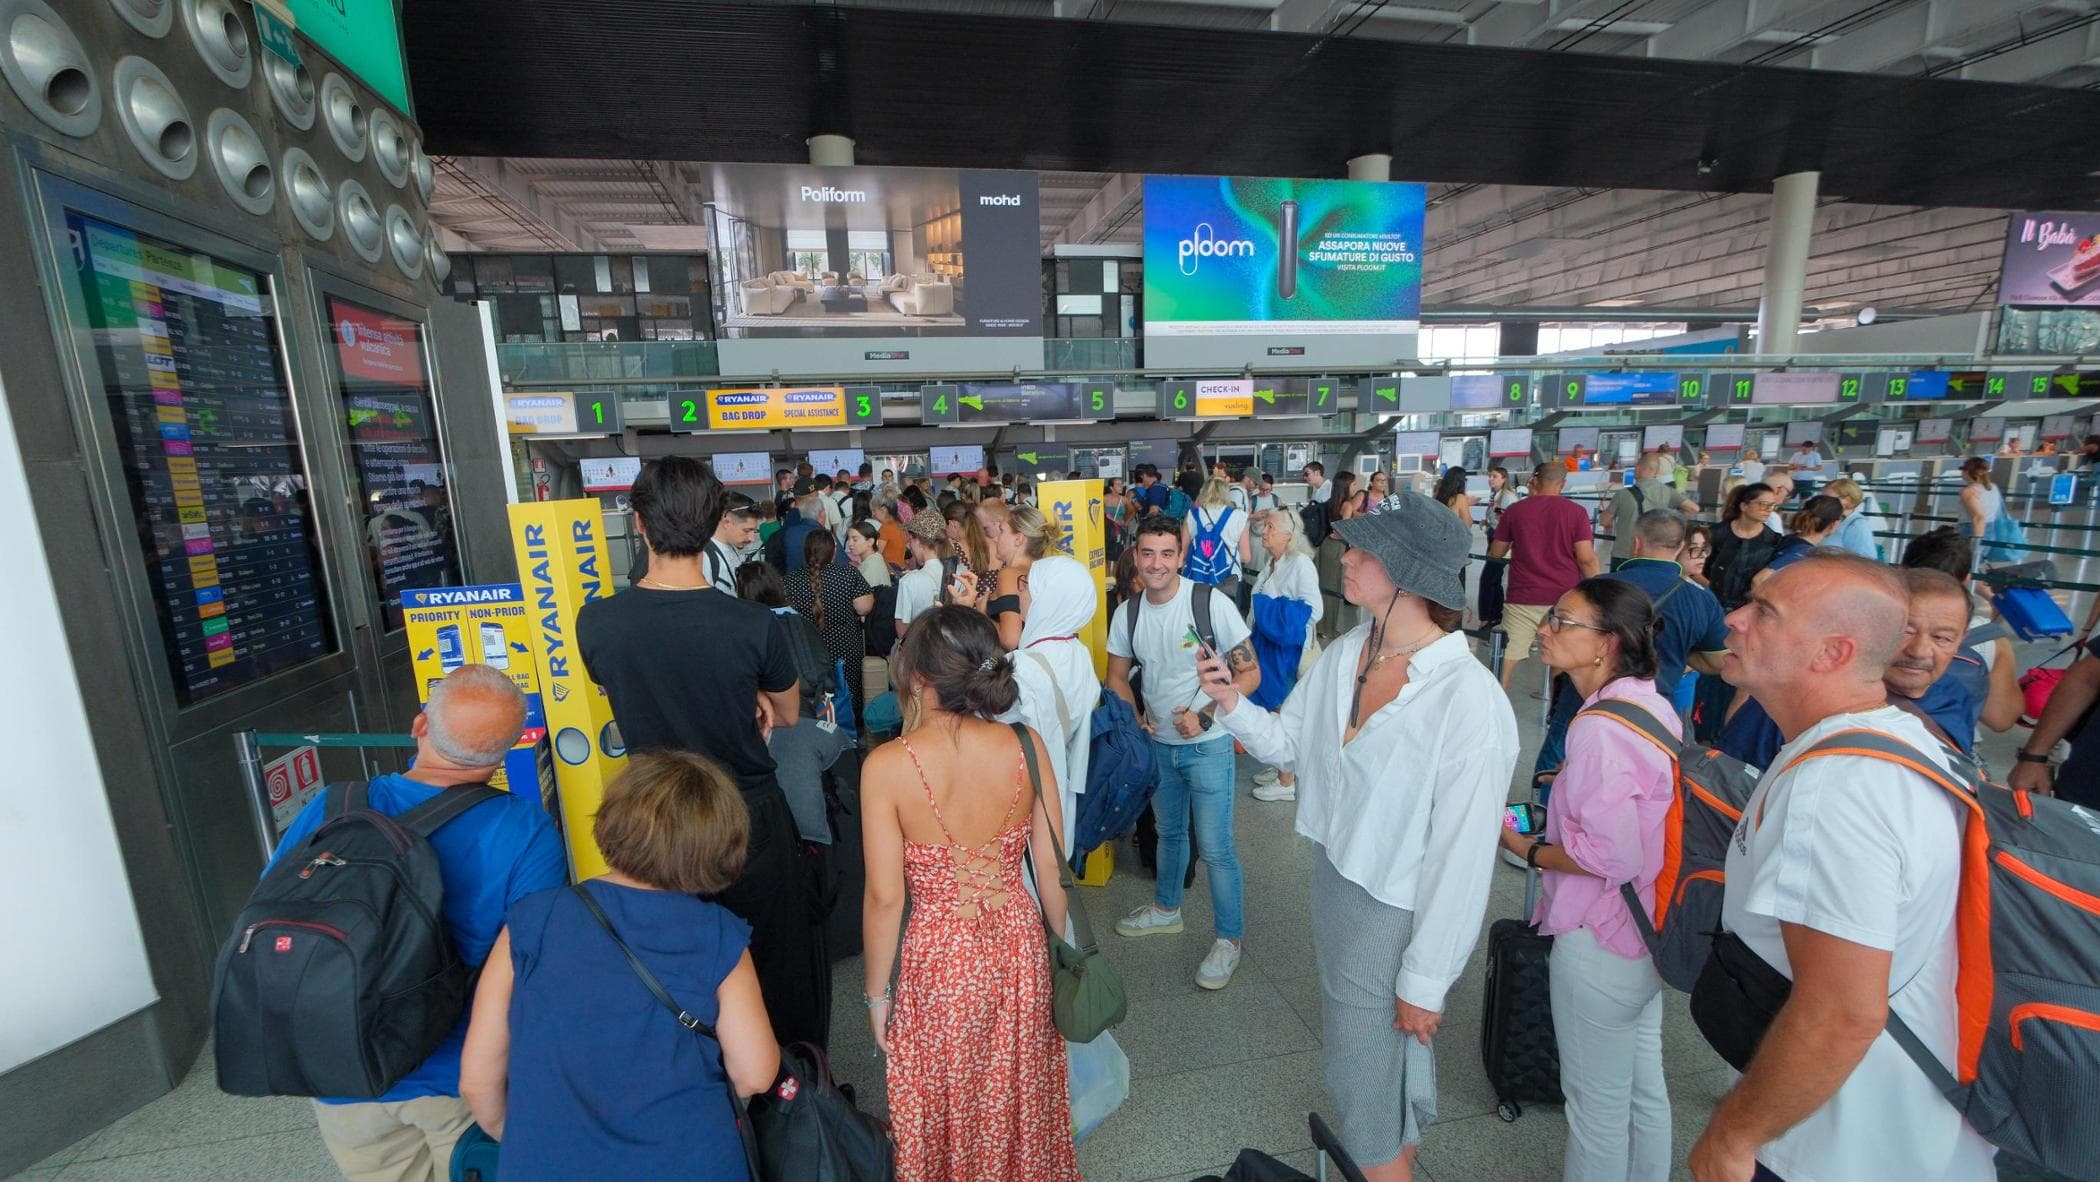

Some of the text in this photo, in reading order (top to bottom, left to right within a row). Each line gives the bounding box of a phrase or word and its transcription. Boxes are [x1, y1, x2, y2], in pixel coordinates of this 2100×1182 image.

[801, 186, 866, 203] Poliform
[979, 194, 1021, 206] mohd
[1318, 240, 1407, 252] ASSAPORA NUOVE
[1308, 251, 1415, 263] SFUMATURE DI GUSTO
[1200, 384, 1240, 394] CHECK-IN
[1509, 382, 1521, 401] 8
[1567, 382, 1579, 400] 9
[1681, 380, 1699, 398] 10
[1735, 379, 1750, 398] 11
[1841, 379, 1859, 397] 12
[1889, 378, 1906, 396] 13
[1987, 377, 2005, 394] 14
[2031, 376, 2049, 393] 15
[724, 394, 768, 404] RYANAIR
[792, 393, 835, 402] RYANAIR
[932, 394, 949, 415] 4
[1091, 391, 1104, 411] 5
[1174, 390, 1188, 409] 6
[1317, 386, 1330, 407] 7
[591, 401, 604, 424] 1
[681, 400, 697, 422] 2
[722, 410, 766, 421] BAG DROP
[784, 408, 840, 418] SPECIAL ASSISTANCE
[856, 396, 872, 417] 3
[572, 519, 604, 605] NAIR
[428, 588, 512, 605] RYANAIR
[524, 523, 570, 678] RYANAIR
[410, 610, 461, 623] PRIORITY
